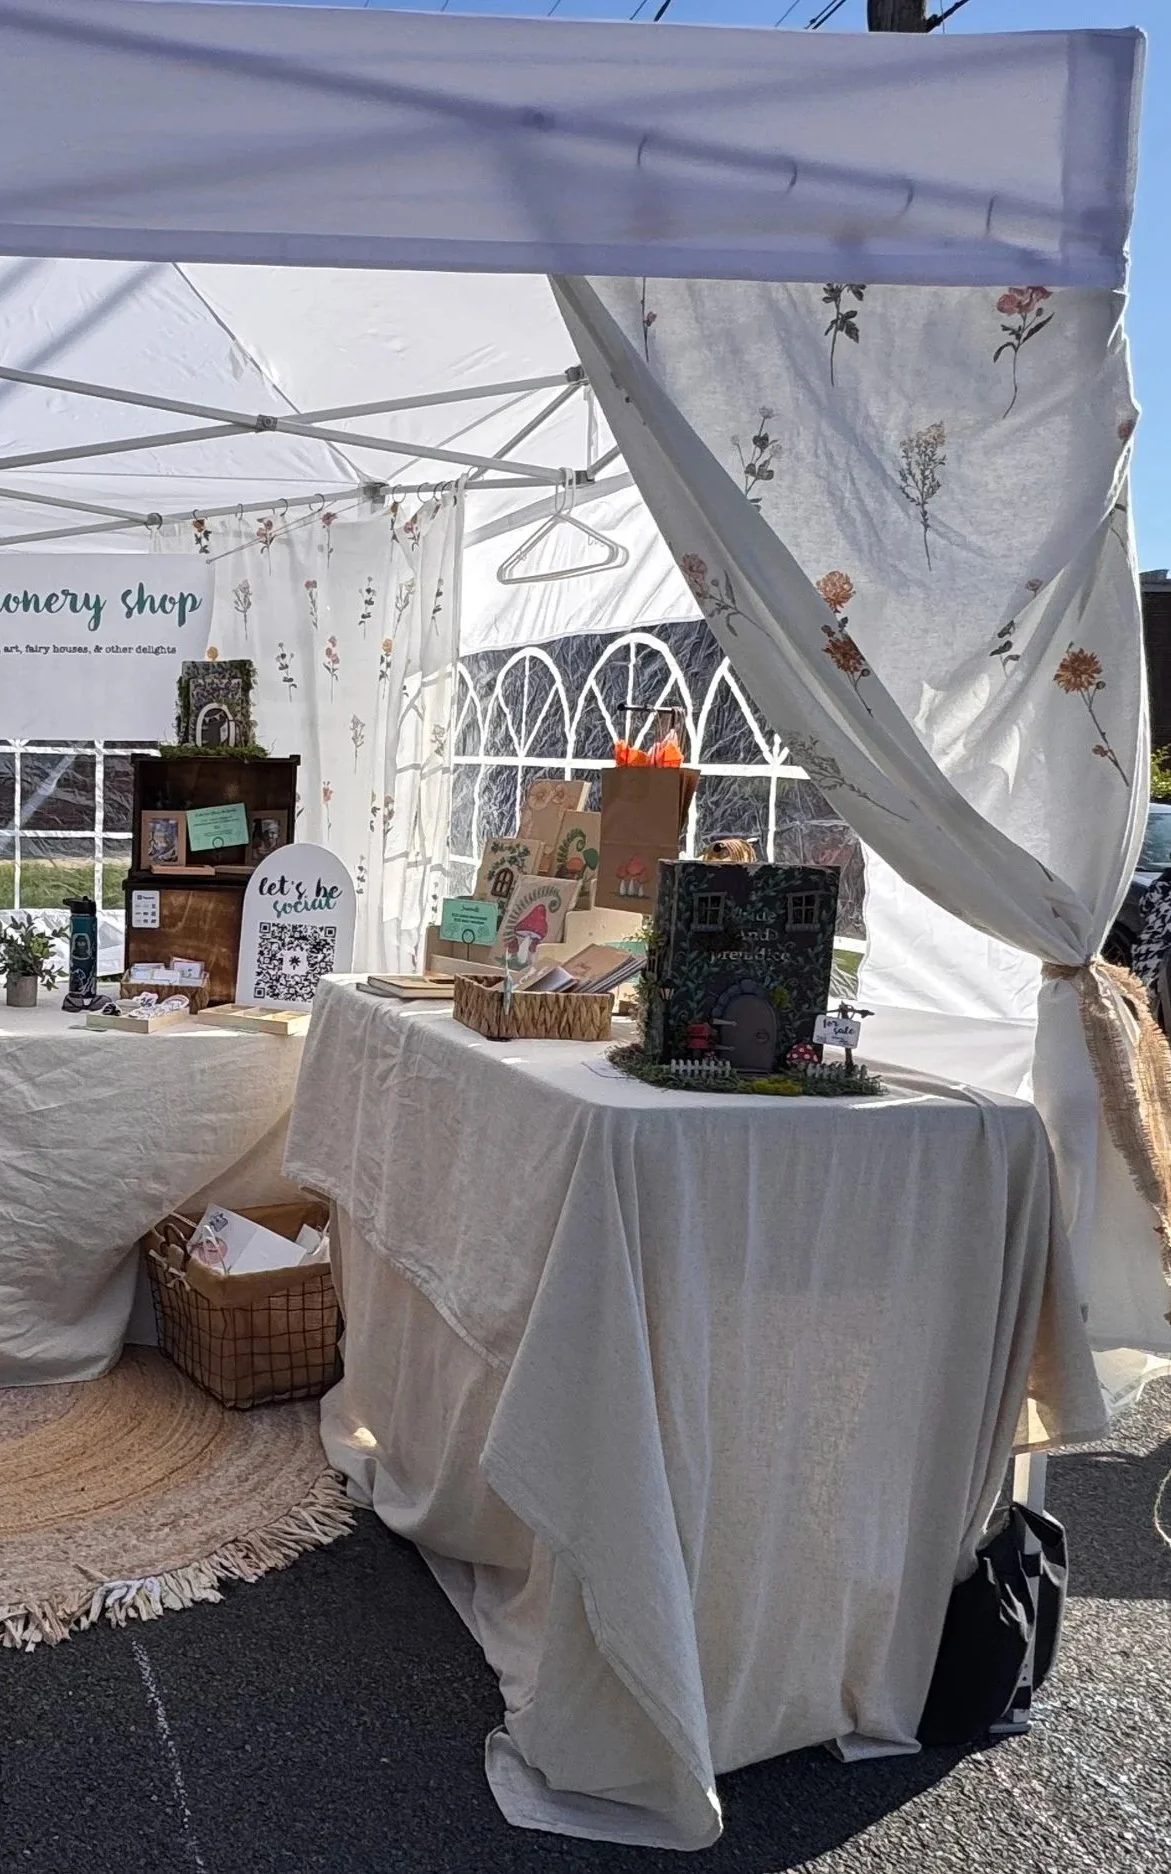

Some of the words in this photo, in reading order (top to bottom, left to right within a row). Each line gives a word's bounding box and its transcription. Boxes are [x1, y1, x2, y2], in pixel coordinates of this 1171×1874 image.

[121, 582, 203, 628] shop
[3, 645, 23, 654] art,
[25, 645, 50, 655] fairy
[52, 645, 92, 655] houses,
[93, 645, 103, 653] &
[105, 645, 133, 654] other
[135, 645, 177, 656] delights
[259, 875, 307, 900] let's
[315, 877, 343, 899] be
[272, 896, 337, 919] social
[823, 1018, 838, 1029] for
[833, 1026, 856, 1035] sale
